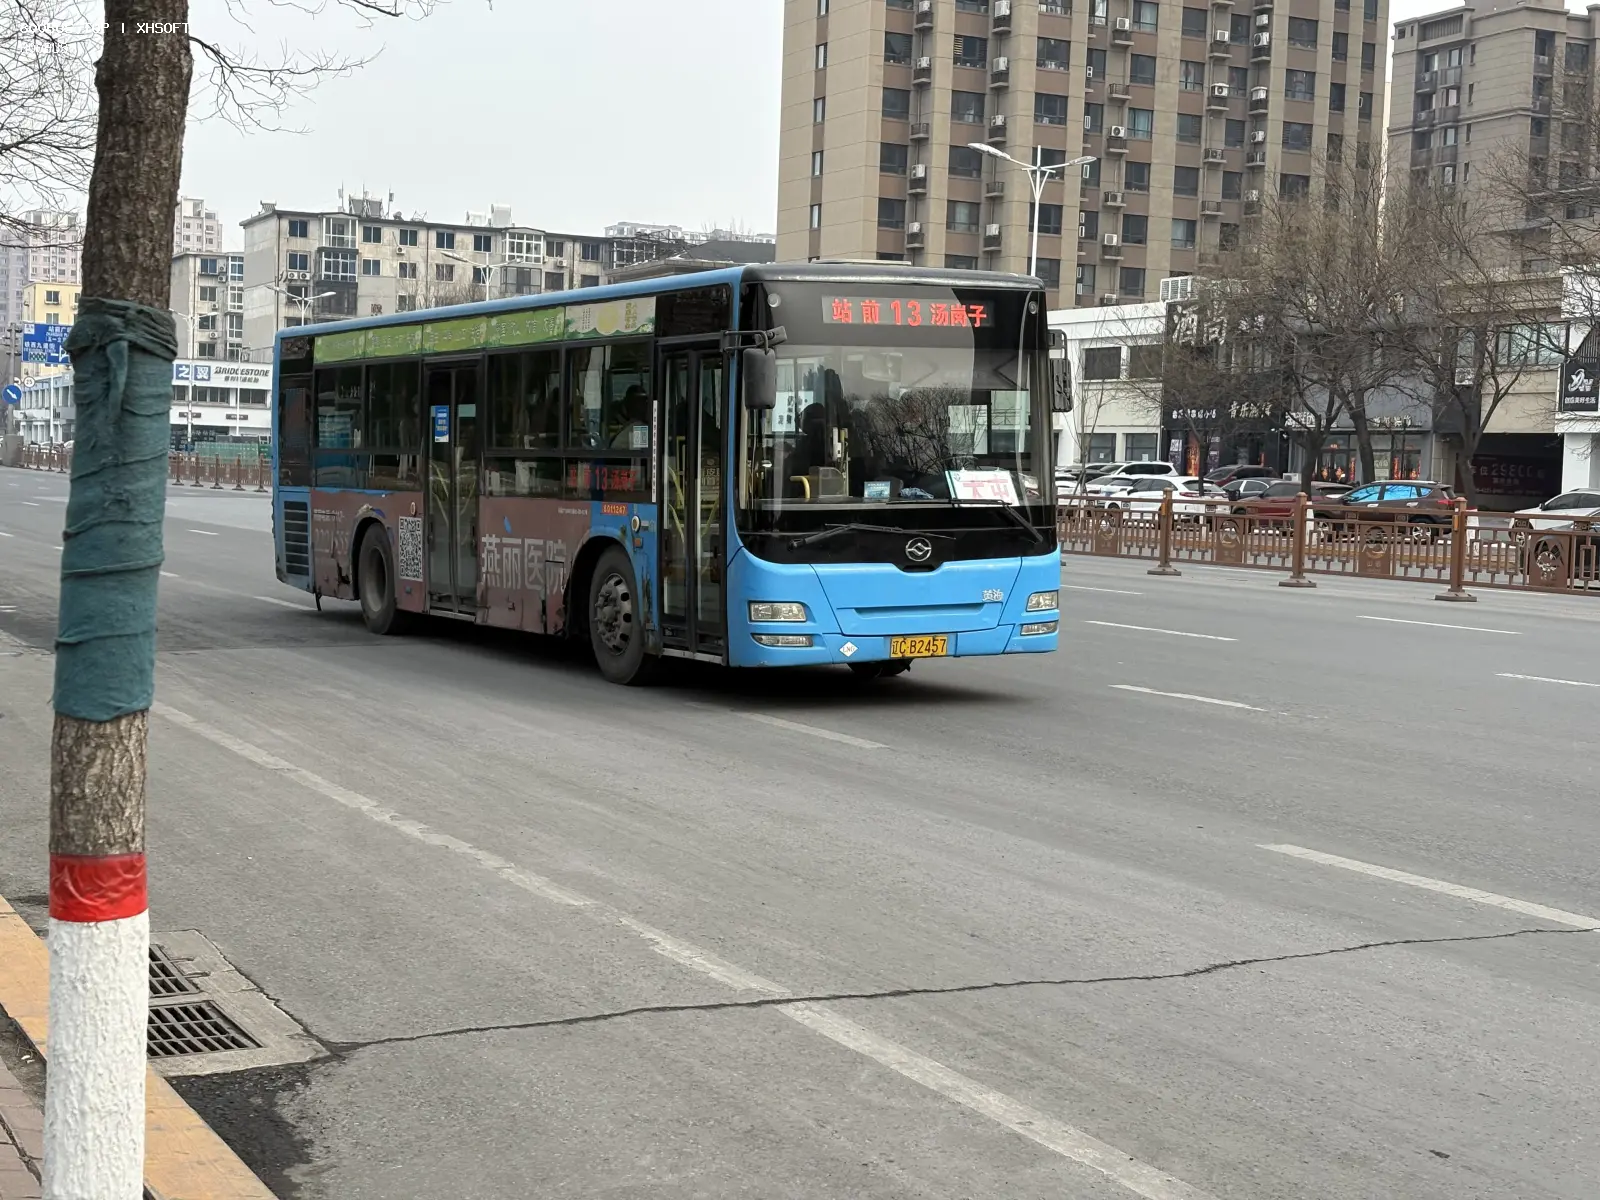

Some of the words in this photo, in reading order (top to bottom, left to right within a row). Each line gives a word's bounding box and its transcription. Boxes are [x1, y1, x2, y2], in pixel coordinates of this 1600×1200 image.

[832, 298, 880, 324] 站前
[890, 300, 922, 327] 13
[930, 303, 987, 328] 汤岗子
[481, 534, 567, 595] 燕丽医院
